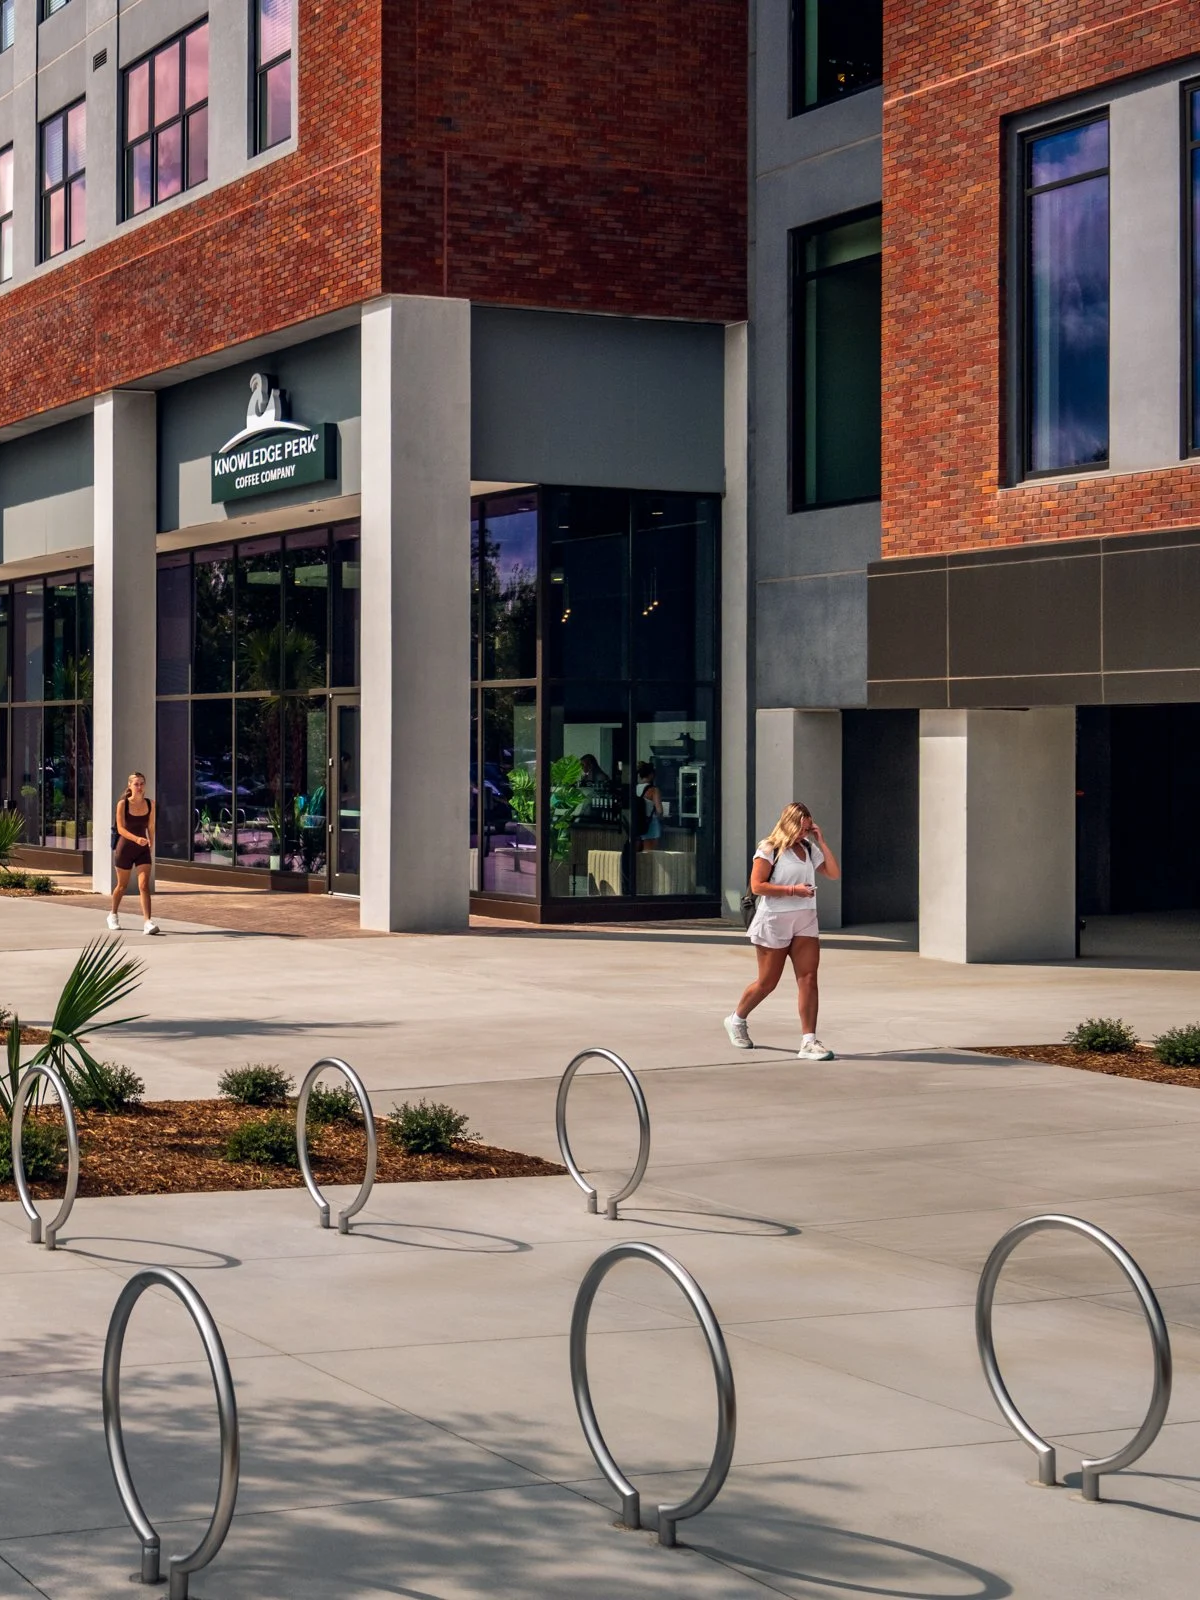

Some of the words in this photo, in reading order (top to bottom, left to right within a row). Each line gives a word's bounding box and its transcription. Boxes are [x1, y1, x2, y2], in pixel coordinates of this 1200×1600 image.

[214, 443, 283, 476] KNOWLEDGE
[235, 474, 260, 490] COFFEE
[260, 464, 296, 483] COMPANY
